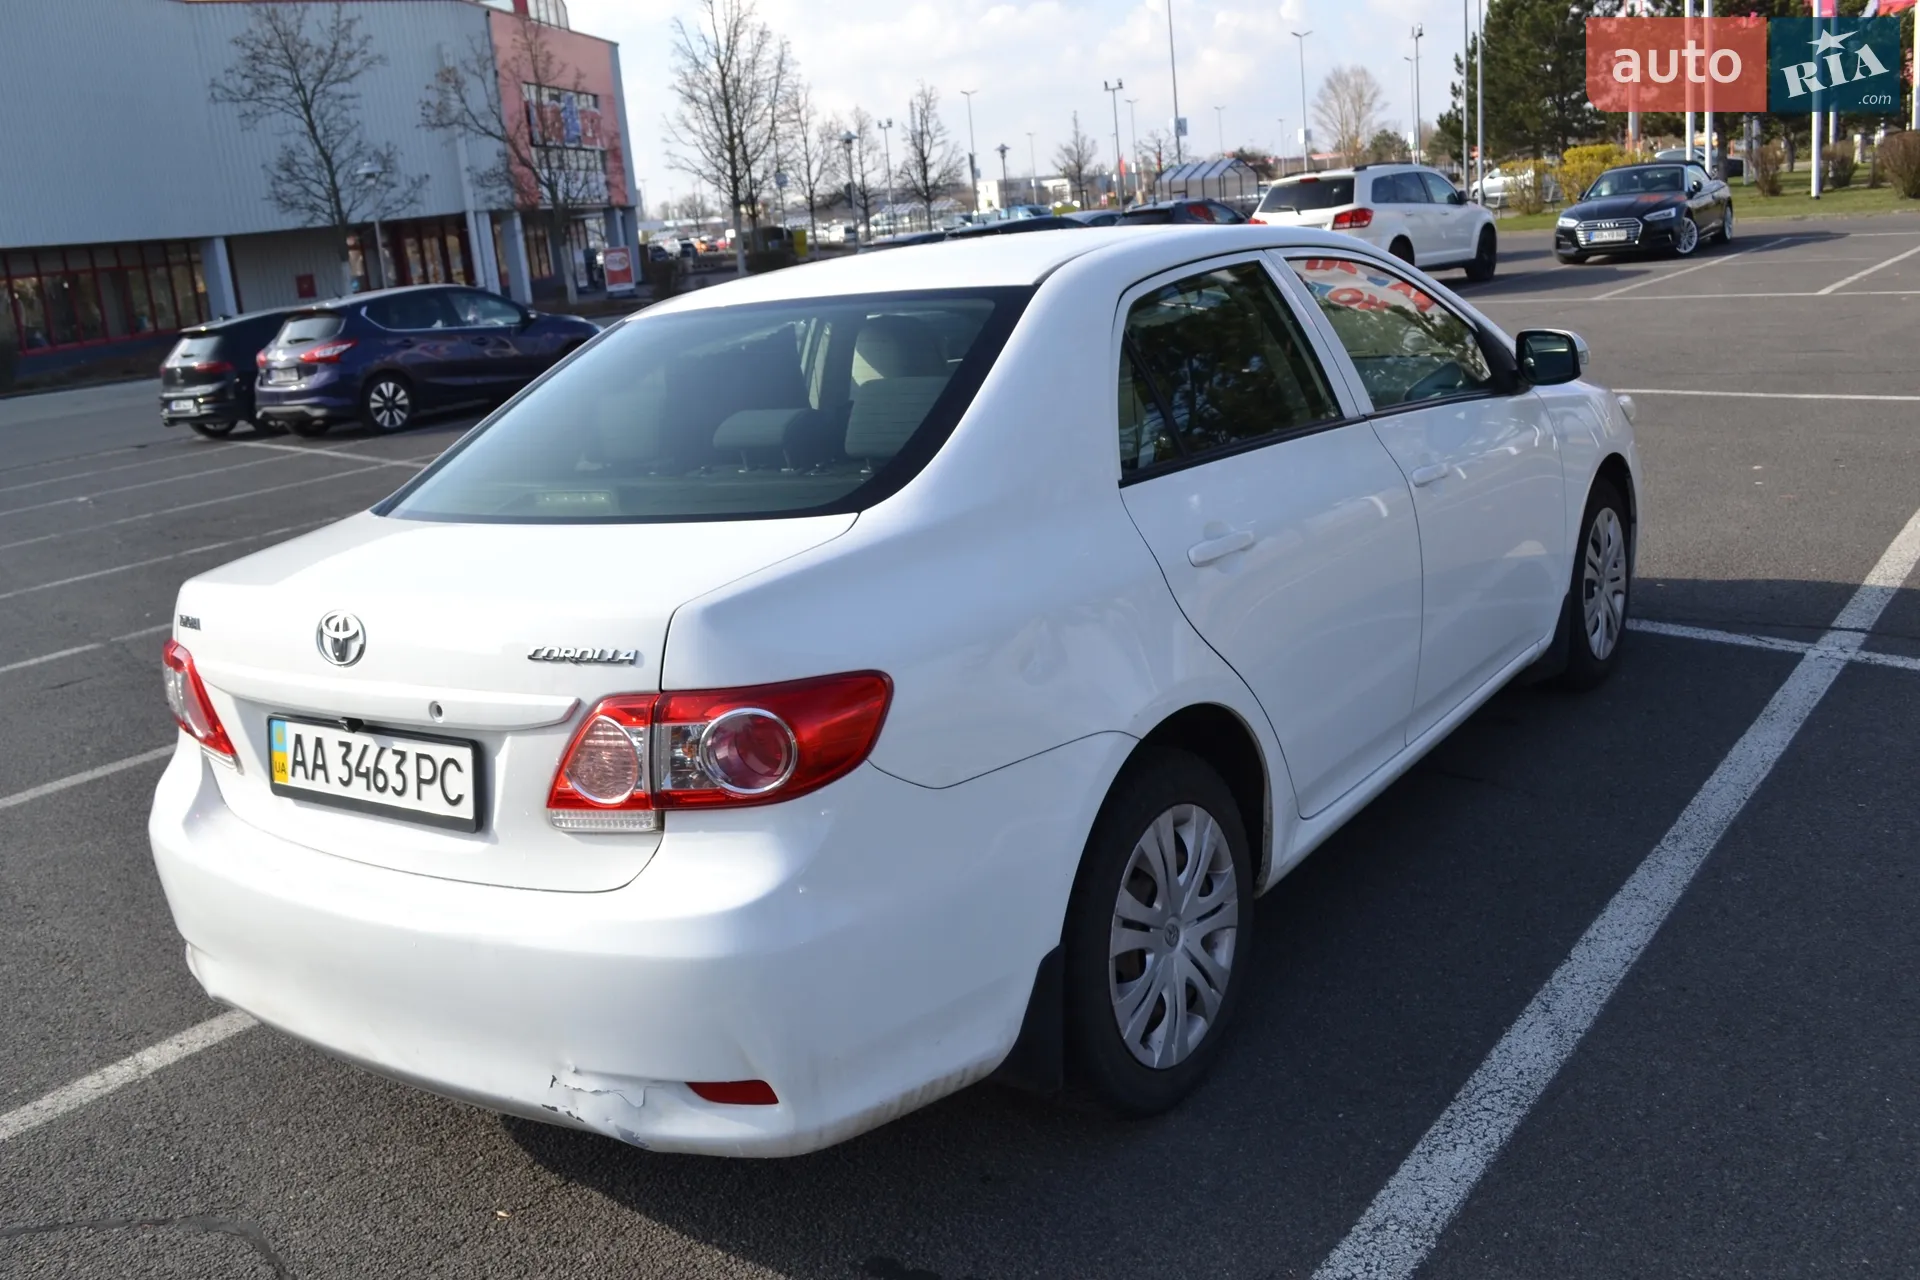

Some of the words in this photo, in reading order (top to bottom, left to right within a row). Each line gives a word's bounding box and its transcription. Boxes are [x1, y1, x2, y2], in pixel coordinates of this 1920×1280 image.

[527, 646, 639, 666] COROLLA
[274, 762, 287, 775] UA
[290, 733, 330, 784] AA
[337, 740, 407, 798] 3463
[415, 751, 465, 807] PC
